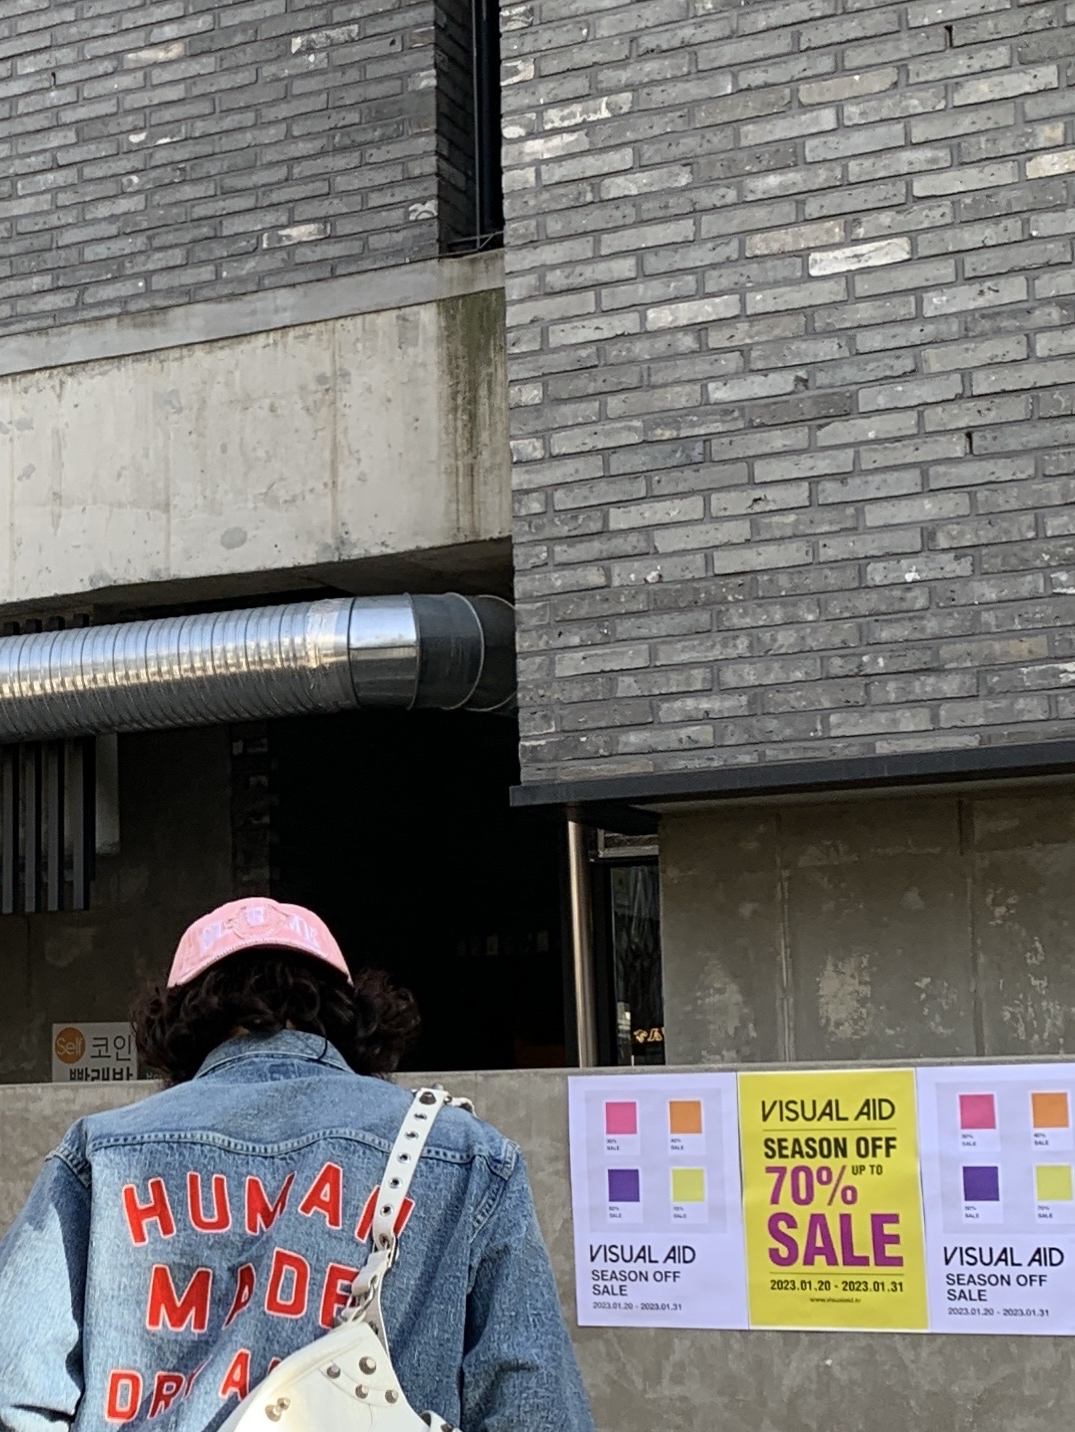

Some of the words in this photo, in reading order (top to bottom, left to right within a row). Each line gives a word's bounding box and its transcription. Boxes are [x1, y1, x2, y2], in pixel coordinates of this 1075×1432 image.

[56, 1037, 84, 1056] Self
[90, 1034, 132, 1062] 코인
[761, 1098, 849, 1122] VISUAL
[853, 1097, 896, 1122] AID
[763, 1136, 848, 1160] SEASON
[856, 1136, 897, 1159] OFF
[851, 1164, 866, 1176] UP
[869, 1164, 883, 1176] TO
[764, 1164, 858, 1207] 70%
[767, 1211, 904, 1267] SALE
[589, 1244, 659, 1264] VISUAL
[663, 1245, 697, 1264] AID
[943, 1246, 1023, 1267] VISUAL
[1027, 1246, 1065, 1267] AID
[591, 1269, 649, 1282] SEASON
[652, 1270, 681, 1283] OFF
[770, 1279, 831, 1291] 2023.01.20
[841, 1280, 904, 1292] 2023.01.31
[945, 1273, 1011, 1286] SEASON
[1016, 1274, 1048, 1287] OFF
[592, 1283, 628, 1296] SALE
[946, 1288, 988, 1302] SALE
[105, 1348, 282, 1425] DRA
